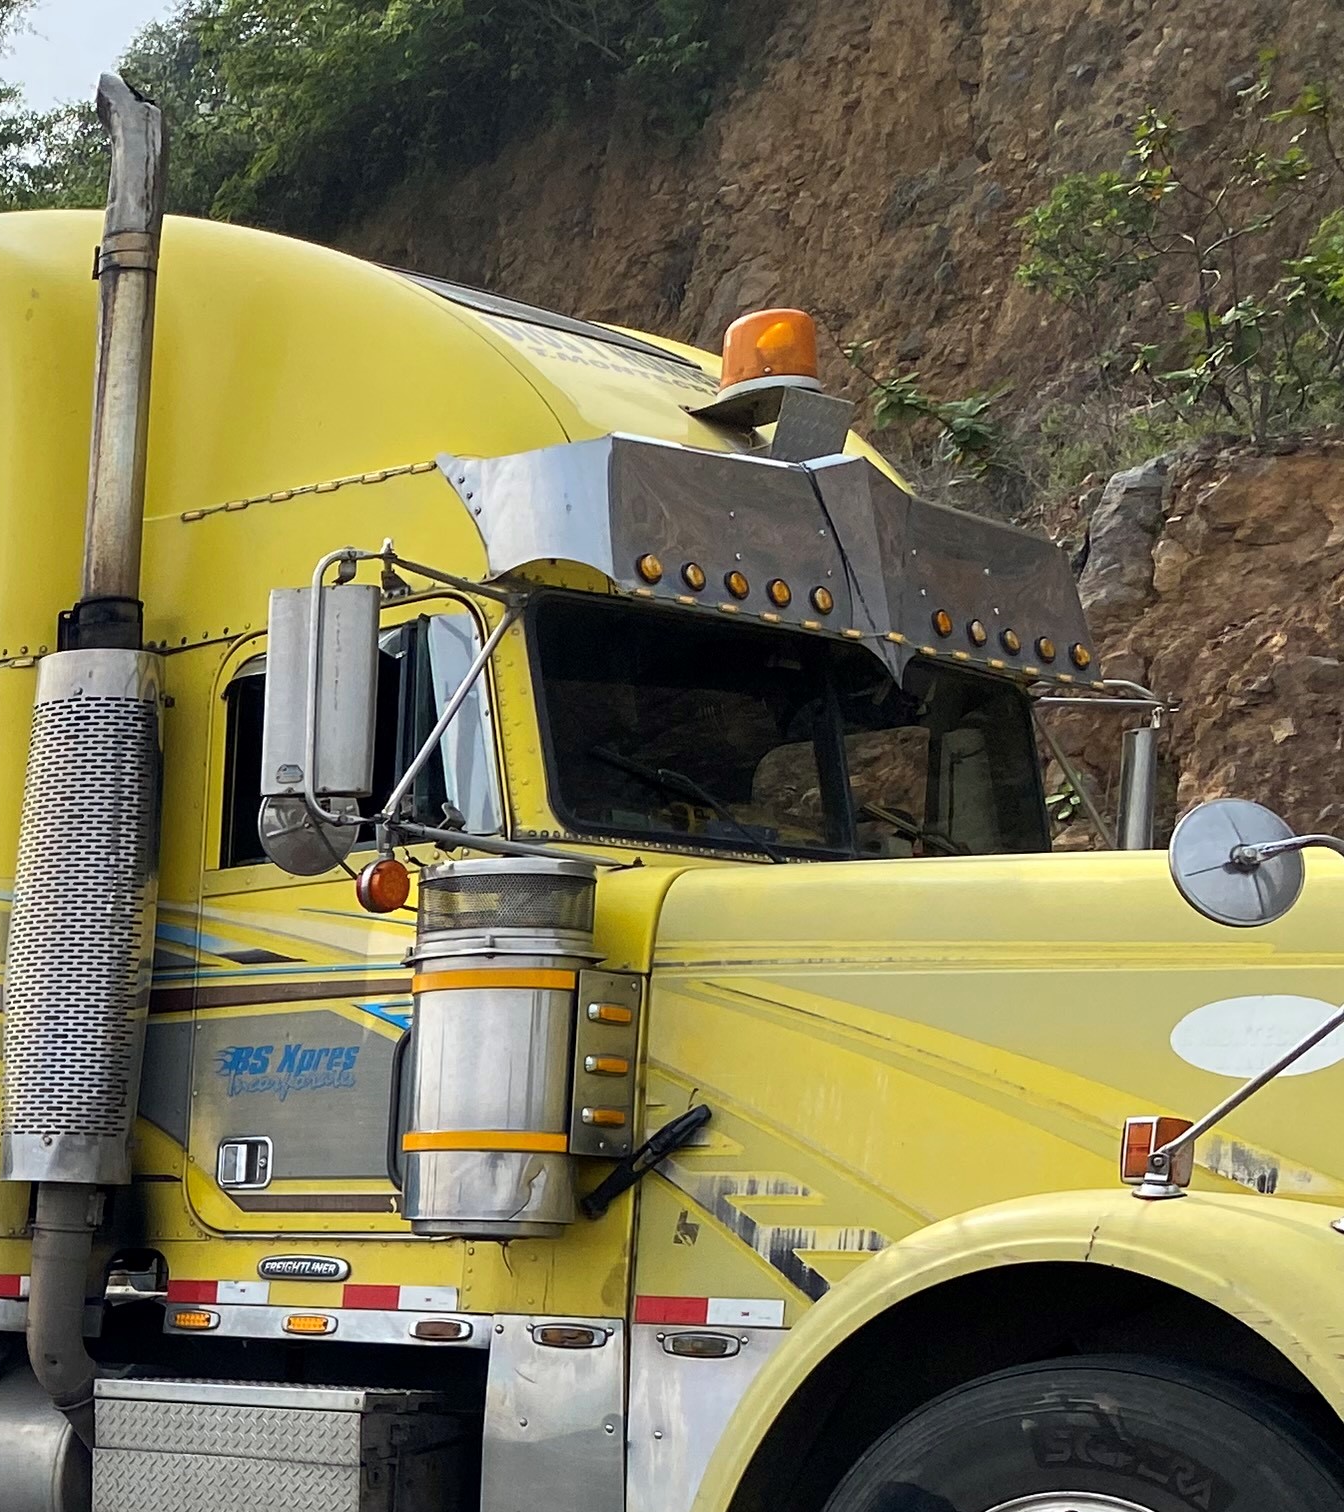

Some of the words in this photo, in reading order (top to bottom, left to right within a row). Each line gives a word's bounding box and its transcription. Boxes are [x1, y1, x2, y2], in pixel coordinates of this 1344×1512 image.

[228, 1045, 274, 1076] BS
[276, 1043, 361, 1077] Xpres
[263, 1261, 337, 1274] FREIGHTLINER
